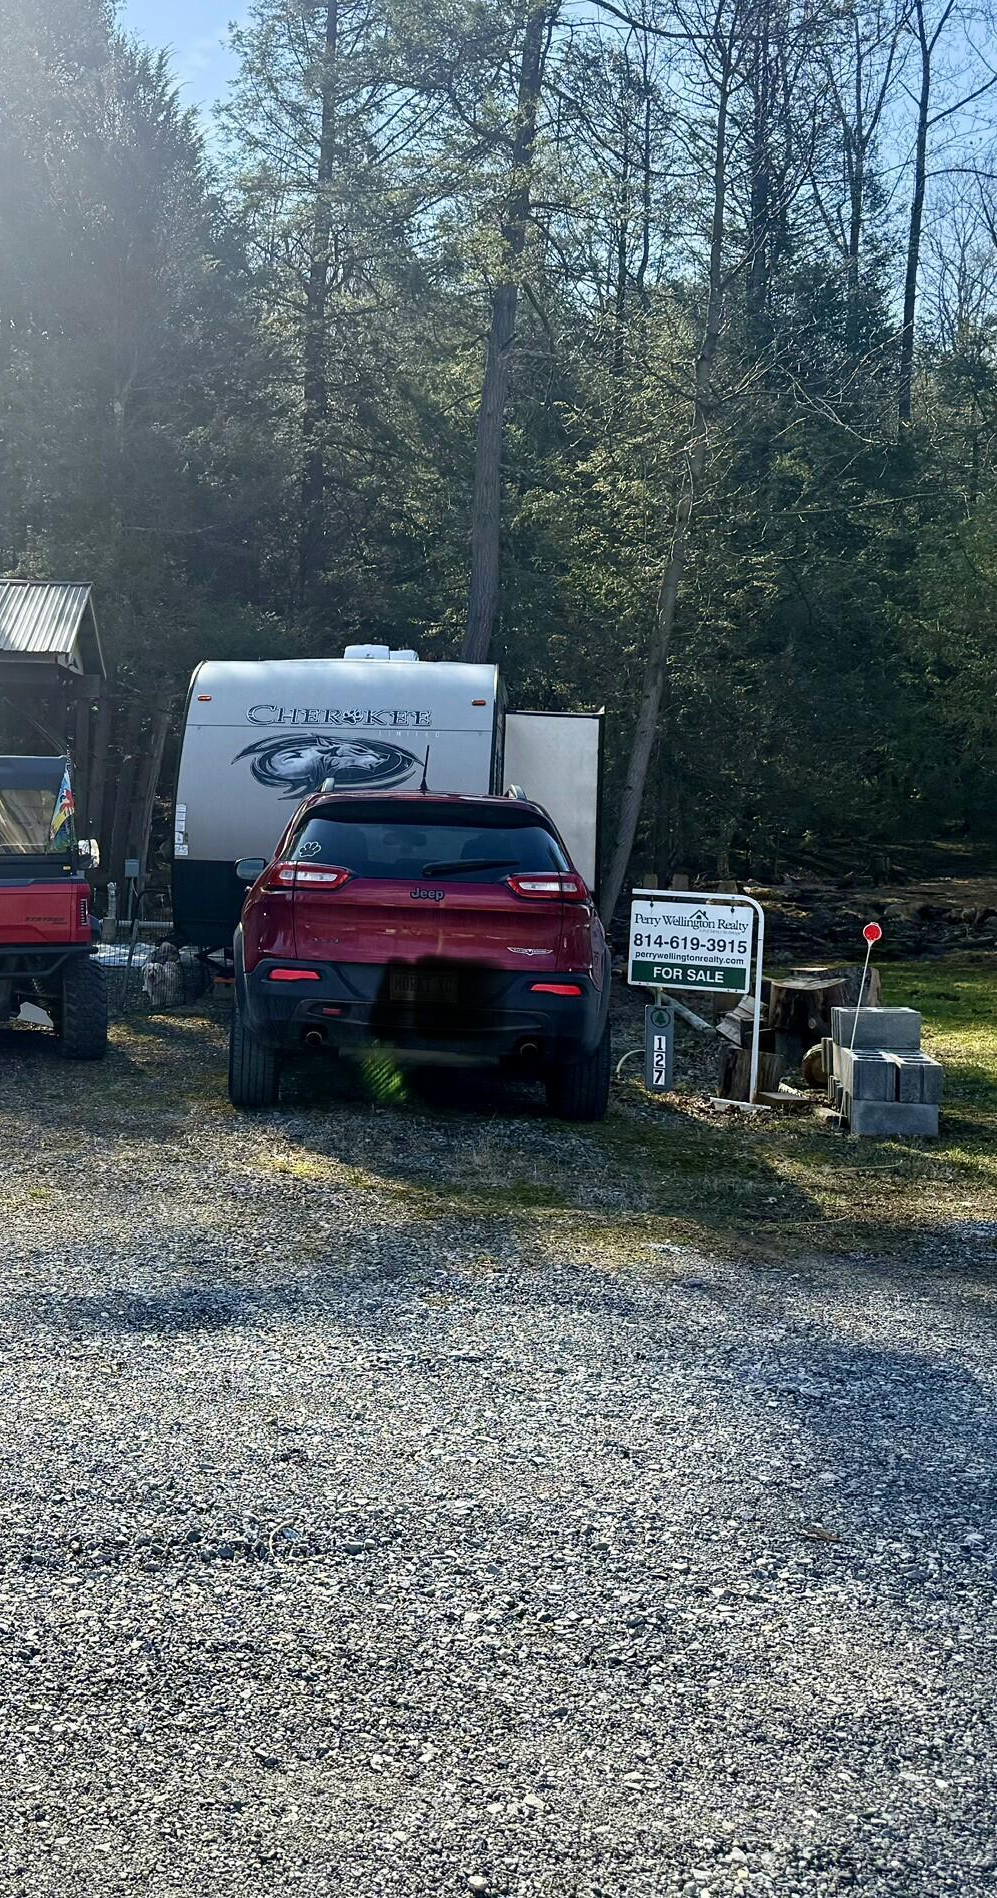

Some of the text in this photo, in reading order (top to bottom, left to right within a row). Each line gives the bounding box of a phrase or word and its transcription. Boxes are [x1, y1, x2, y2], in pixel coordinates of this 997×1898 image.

[411, 887, 445, 902] Jeep
[634, 913, 662, 928] Perry
[662, 914, 716, 930] Wellington
[717, 918, 750, 934] Realty
[633, 932, 748, 954] 814-619-3915
[634, 950, 745, 965] perrywellingtonrealty.com
[653, 966, 725, 984] FOR SALE
